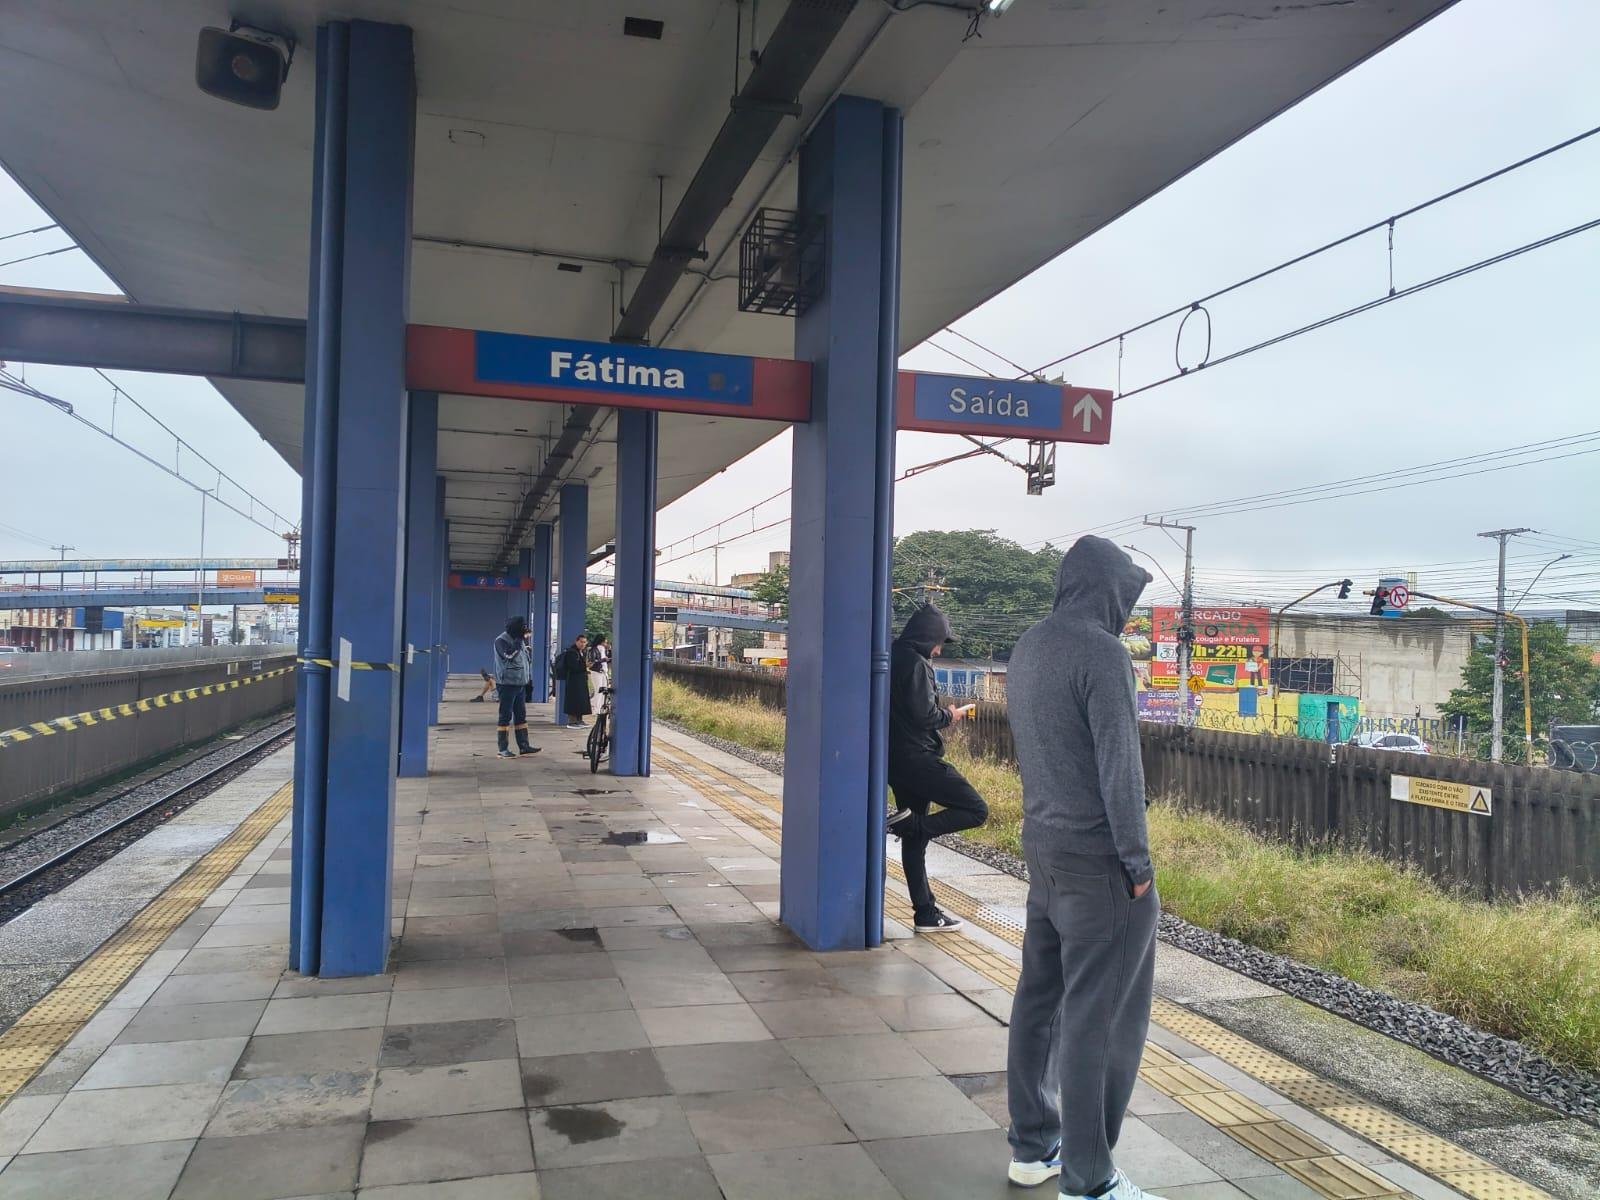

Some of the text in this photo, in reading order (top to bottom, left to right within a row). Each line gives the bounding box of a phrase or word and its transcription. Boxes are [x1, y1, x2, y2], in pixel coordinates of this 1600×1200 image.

[550, 351, 685, 389] Fátima
[949, 387, 1029, 417] Saída
[1174, 610, 1241, 620] MRCADO
[1215, 645, 1248, 658] 22h
